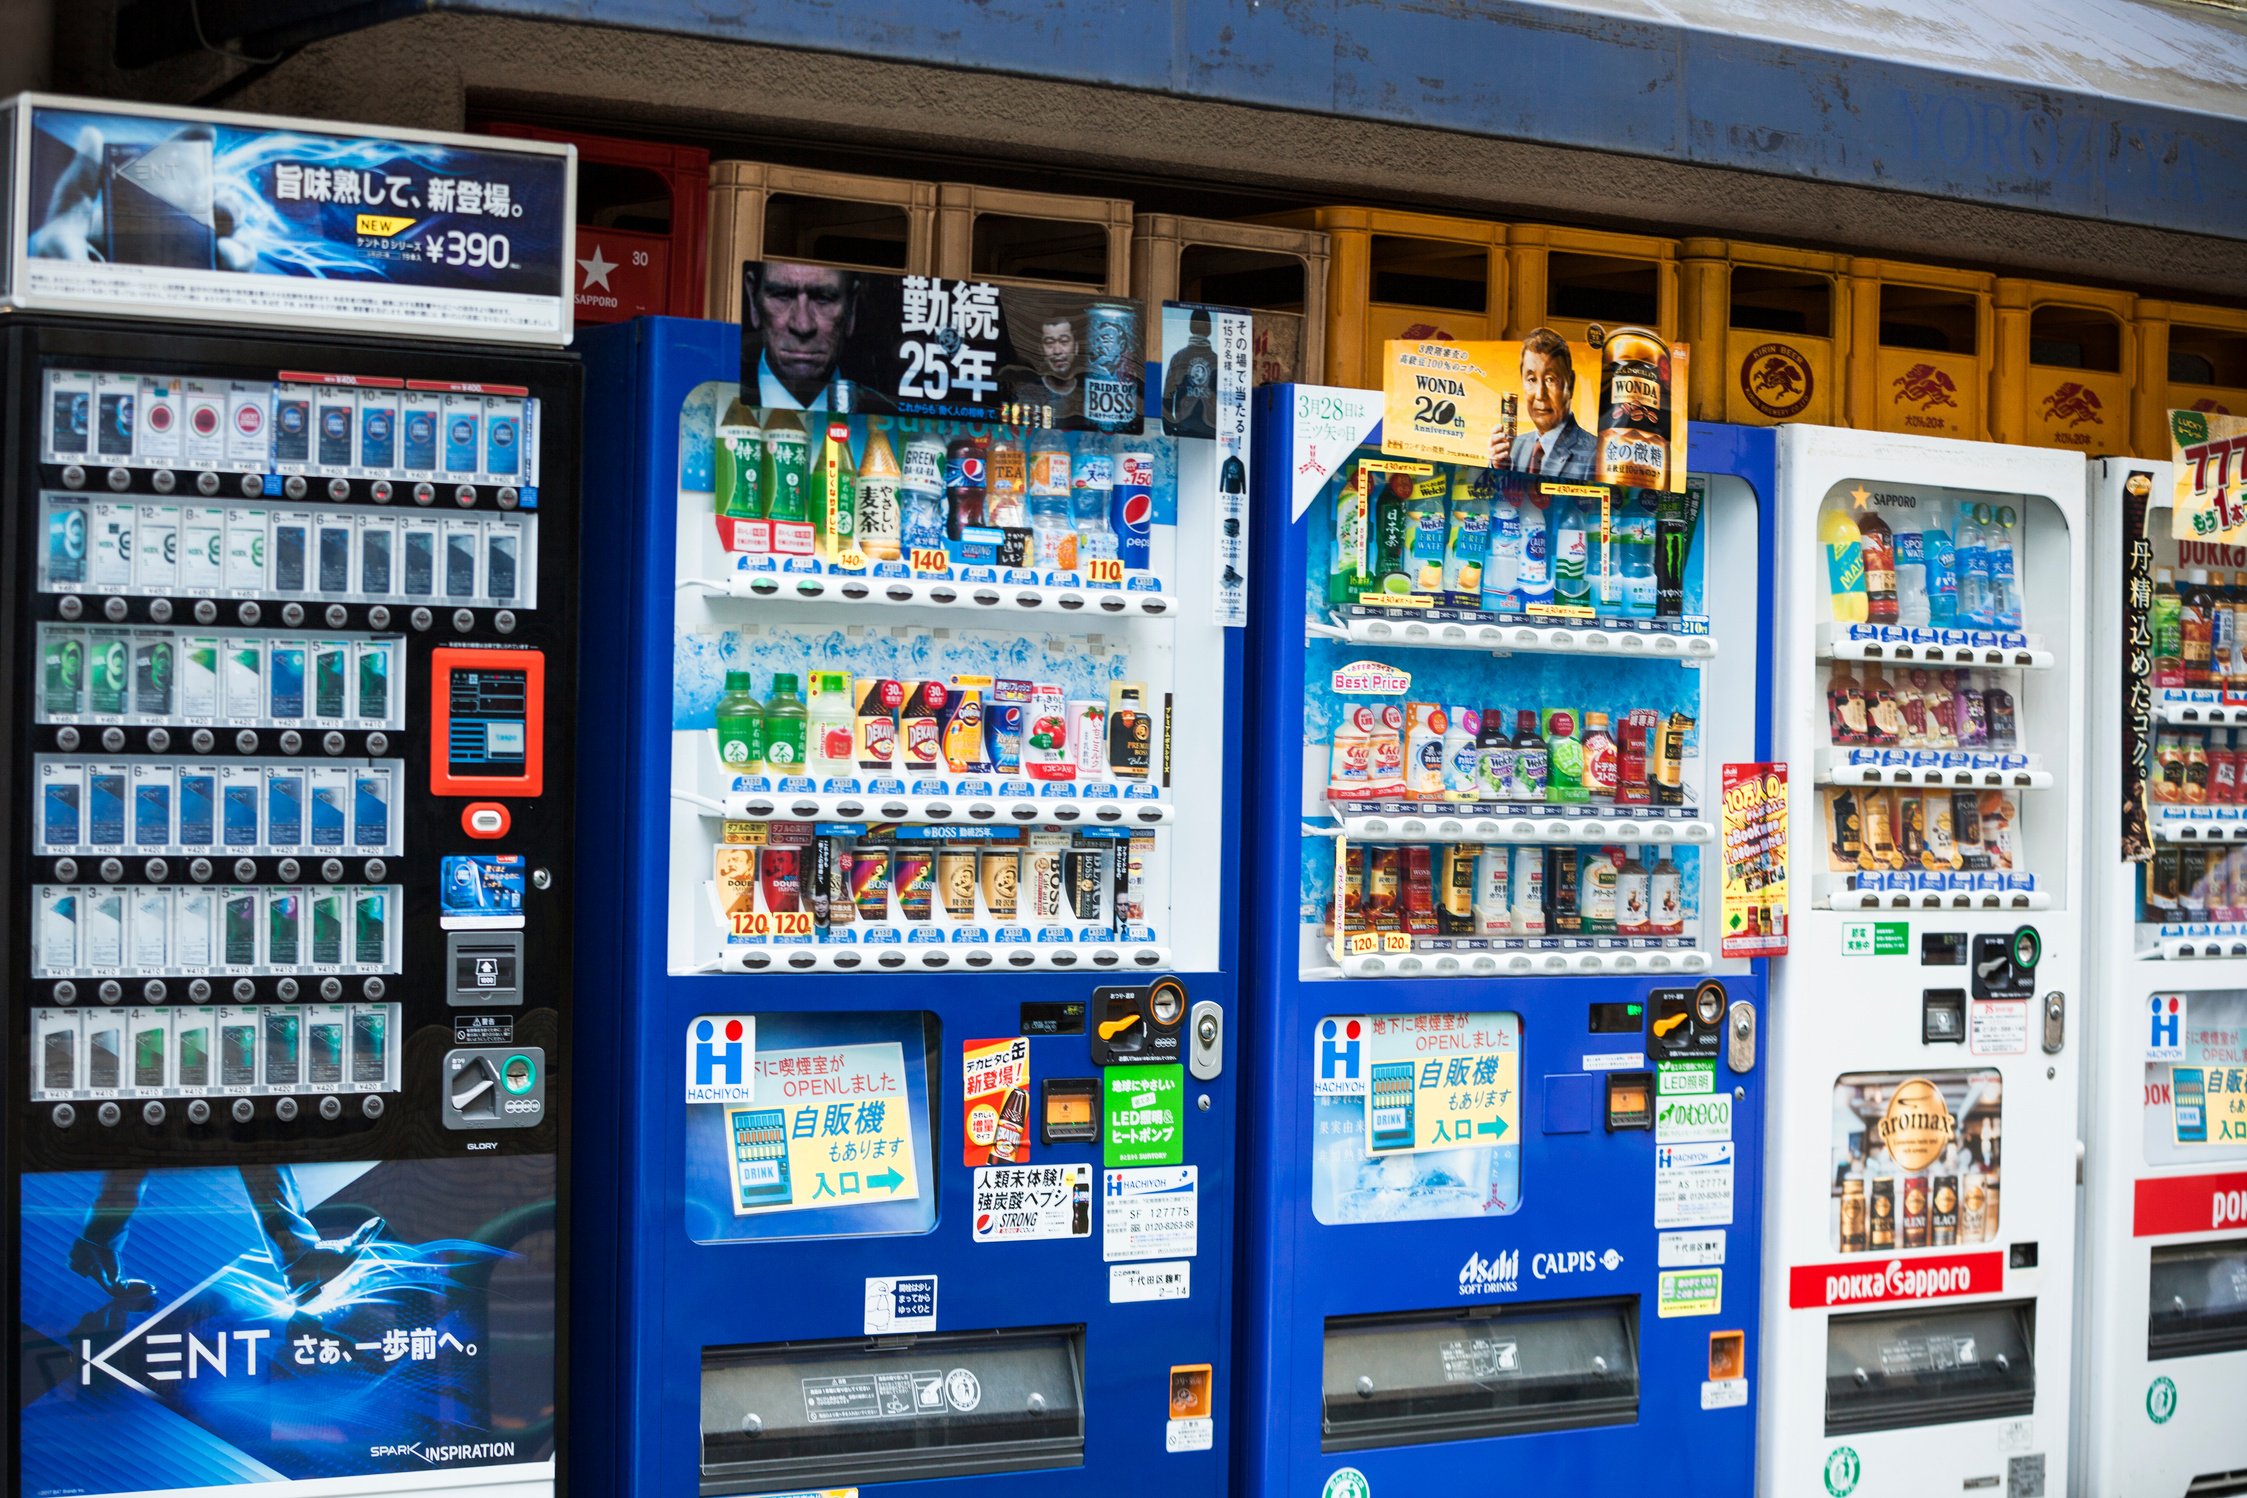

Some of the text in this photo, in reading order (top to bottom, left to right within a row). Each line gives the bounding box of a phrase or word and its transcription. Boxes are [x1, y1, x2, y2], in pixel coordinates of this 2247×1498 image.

[360, 219, 393, 233] NEW
[631, 250, 649, 267] 30
[901, 275, 1000, 341] 勤続
[898, 340, 998, 402] 25年
[1088, 381, 1118, 393] PRIDE
[1415, 374, 1466, 397] WONDA
[1615, 380, 1659, 400] WONDA
[1088, 391, 1135, 413] BOSS
[830, 428, 847, 438] NEW
[1297, 421, 1356, 443] 三ツ矢の日
[1414, 423, 1465, 439] Anniversary
[905, 450, 937, 466] GREEN
[1606, 440, 1663, 468] 金の微糖
[996, 466, 1023, 478] TEA
[859, 485, 880, 533] 麦茶
[1873, 493, 1917, 509] SAPPORO
[1335, 674, 1407, 690] Best Price
[931, 827, 957, 837] BOSS
[1372, 1012, 1470, 1036] 地下に喫煙室が
[1415, 1029, 1510, 1051] OPENしました
[1418, 1054, 1500, 1090] 自販機
[687, 1087, 749, 1100] HACHIYOH
[783, 1072, 896, 1097] OPENしました
[1314, 1081, 1365, 1093] HACHIYOH
[1448, 1089, 1513, 1112] もあります
[791, 1100, 886, 1140] 自販機
[1376, 1113, 1402, 1126] DRINK
[1880, 1111, 1953, 1138] aromax
[1112, 1125, 1175, 1144] ヒートポンプ
[1431, 1119, 1473, 1145] 入口
[466, 1142, 499, 1151] GLORY
[828, 1137, 905, 1163] もあります
[743, 1166, 775, 1181] DRINK
[977, 1168, 1065, 1190] 人類未体験!
[1123, 1178, 1167, 1189] HACHIYOH
[811, 1170, 860, 1200] 入口
[977, 1192, 1068, 1212] 強炭酸ペプシ
[1150, 1206, 1190, 1218] 127775
[999, 1212, 1038, 1228] STRONG
[1458, 1249, 1520, 1284] Asahi
[1531, 1250, 1596, 1280] CALPIS
[1458, 1282, 1518, 1296] SOFT DRINKS
[81, 1329, 271, 1387] KENT
[370, 1440, 516, 1463] SPARK INSPIRATION
